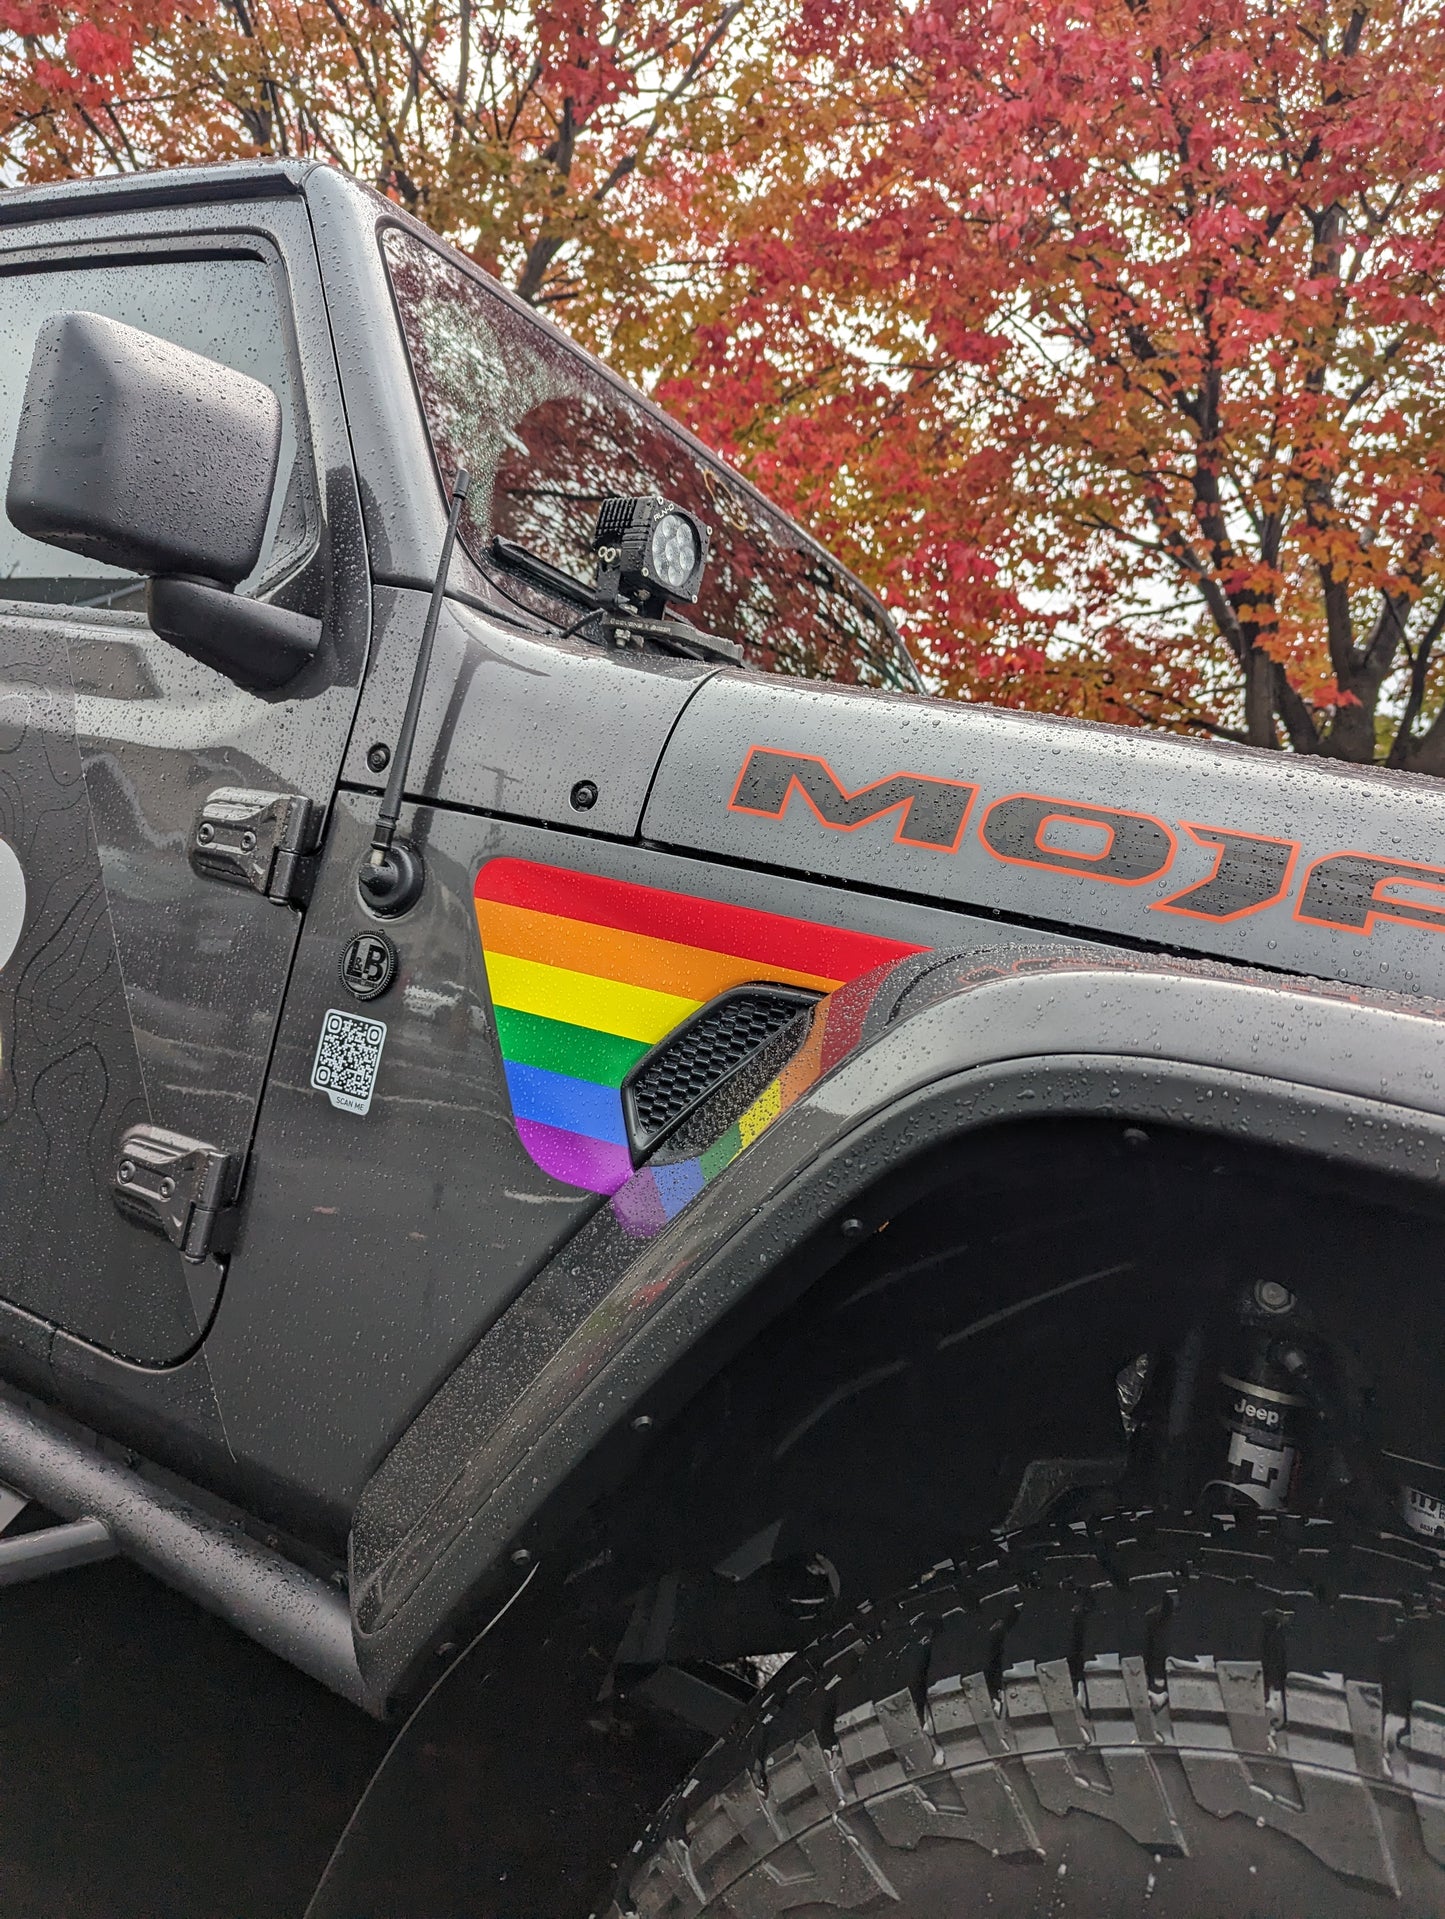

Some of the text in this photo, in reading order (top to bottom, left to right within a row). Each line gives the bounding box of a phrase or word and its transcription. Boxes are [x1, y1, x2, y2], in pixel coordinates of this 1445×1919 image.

[336, 1096, 365, 1112] SCAN ME
[1233, 1398, 1280, 1426] Jeep
